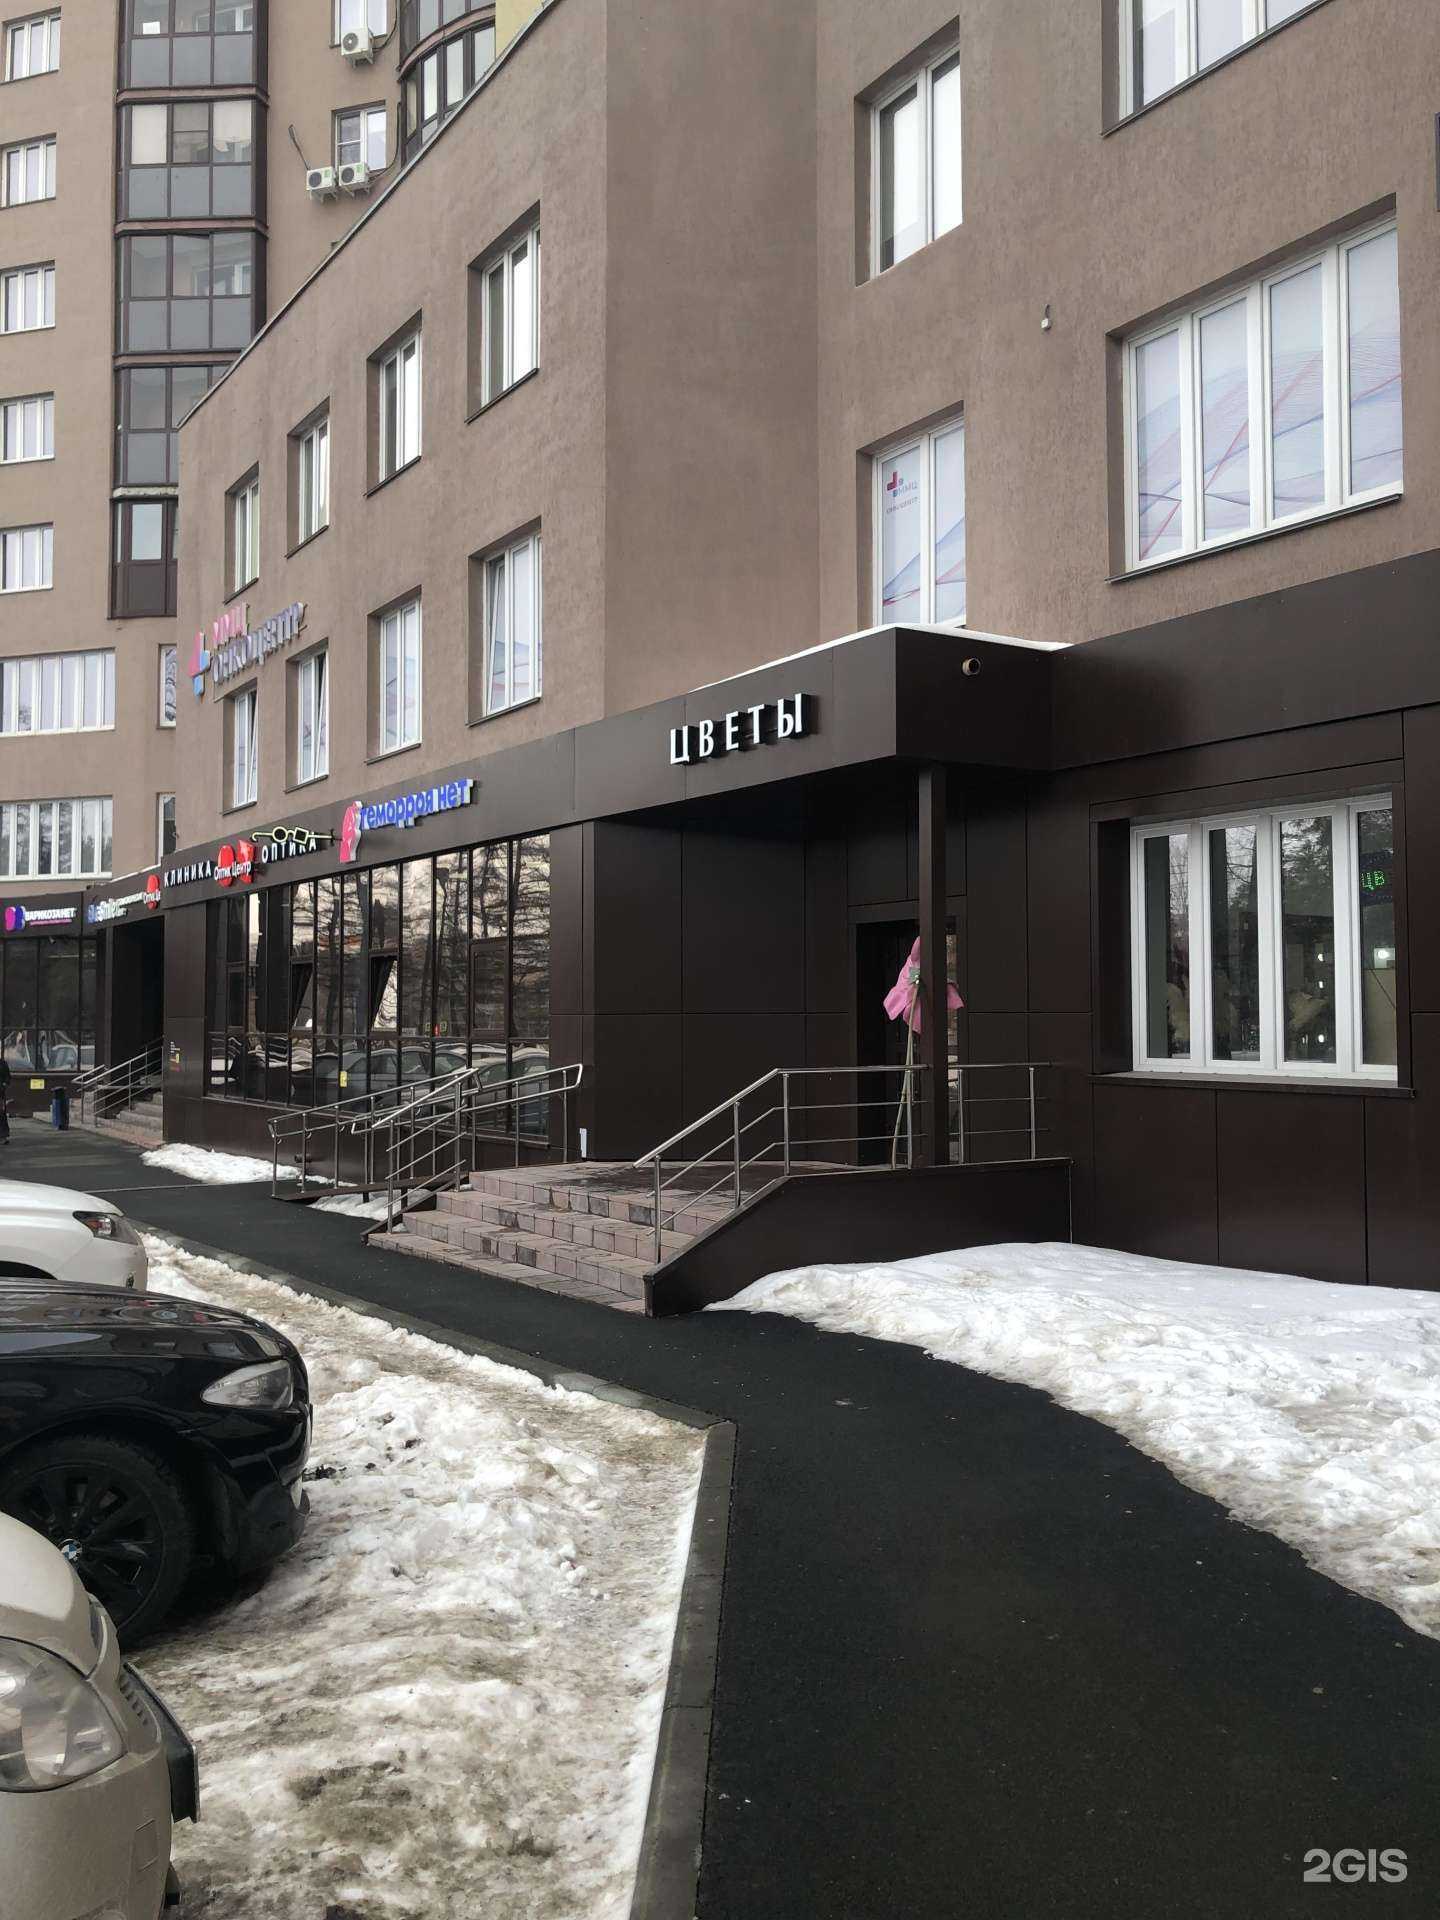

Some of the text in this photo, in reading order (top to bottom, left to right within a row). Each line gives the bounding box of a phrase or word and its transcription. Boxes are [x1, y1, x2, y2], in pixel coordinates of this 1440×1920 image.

[670, 693, 803, 765] ЦВЕТЫ
[164, 860, 212, 888] КЛИНИКА
[261, 832, 317, 864] ОПТИКА
